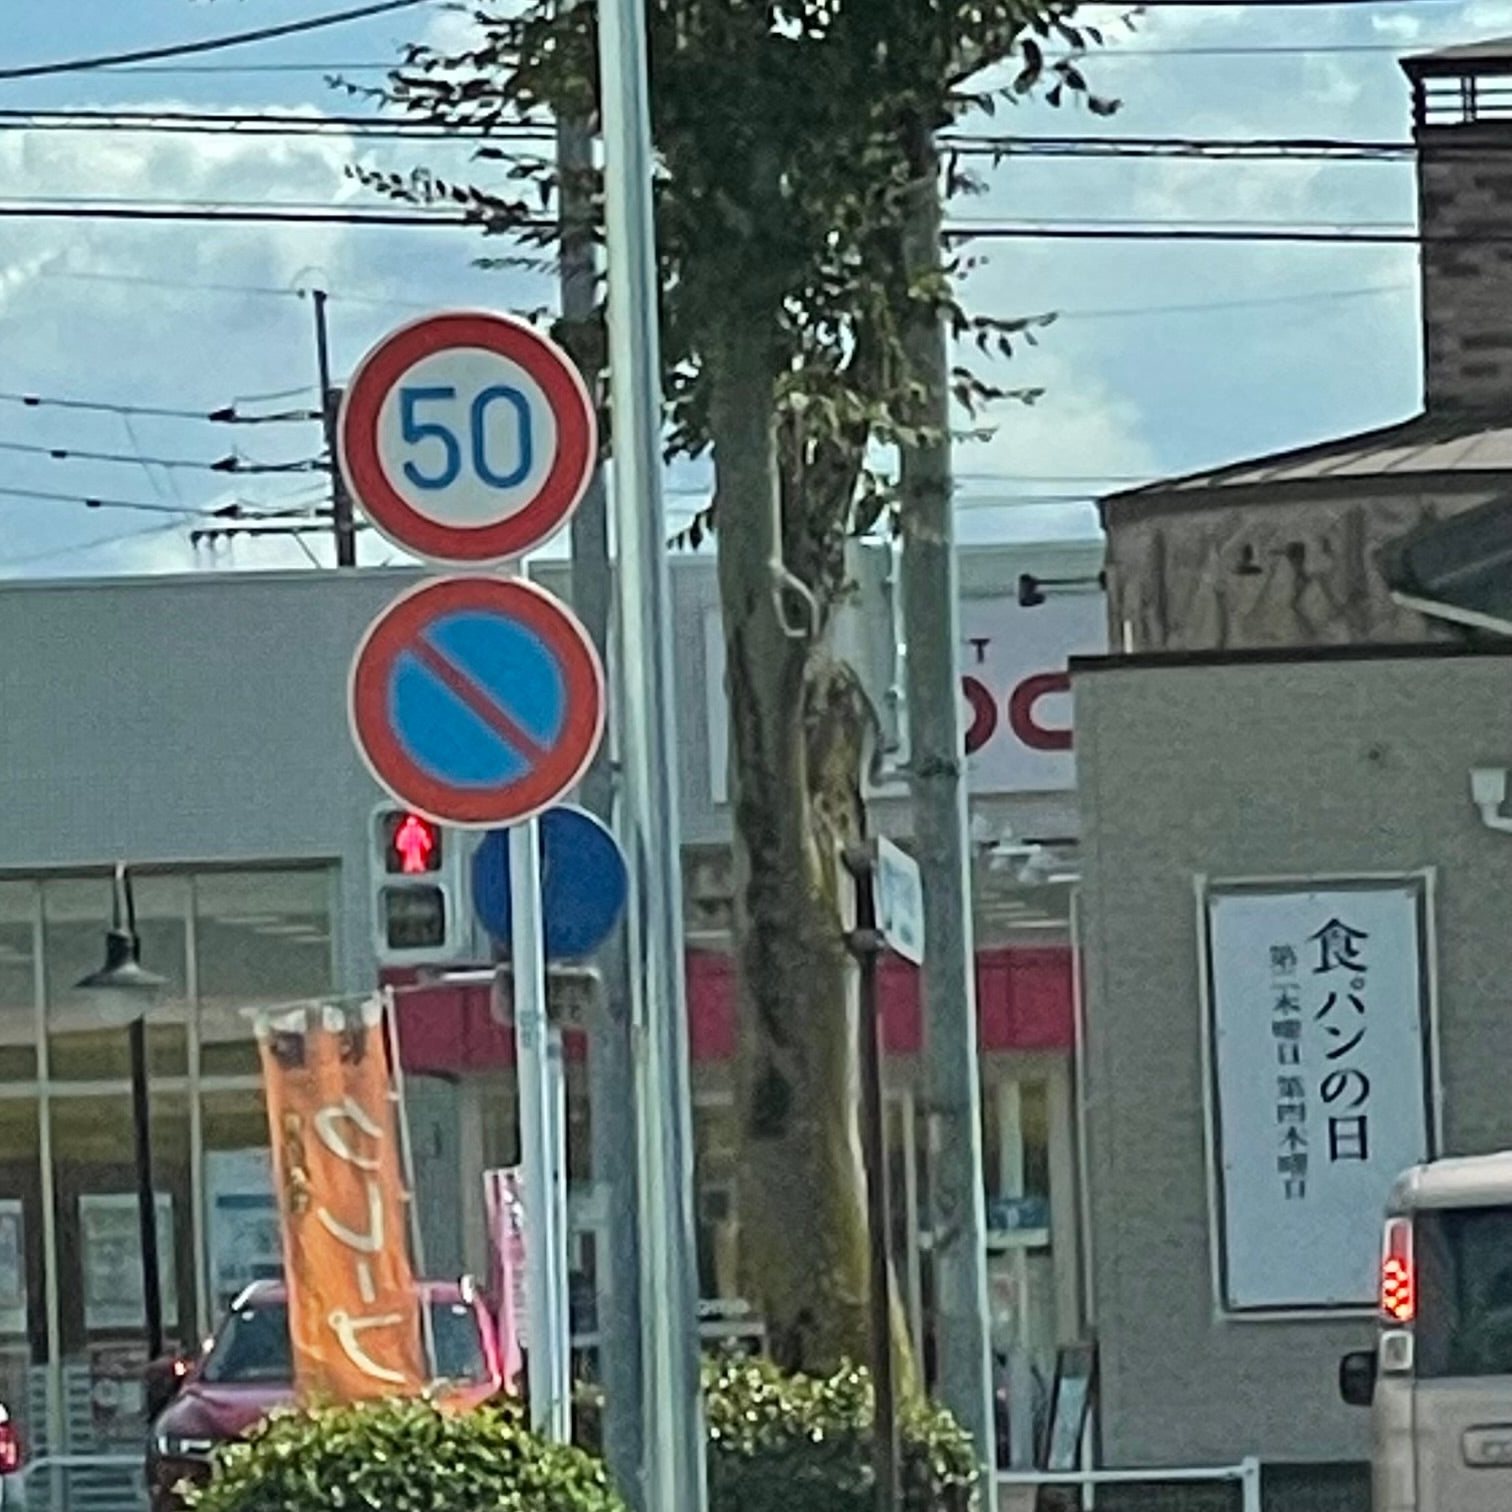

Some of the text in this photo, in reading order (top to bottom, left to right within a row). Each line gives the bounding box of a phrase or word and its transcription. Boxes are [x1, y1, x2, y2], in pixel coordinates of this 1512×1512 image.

[400, 385, 533, 490] 50
[1306, 917, 1370, 1162] 食パンの日
